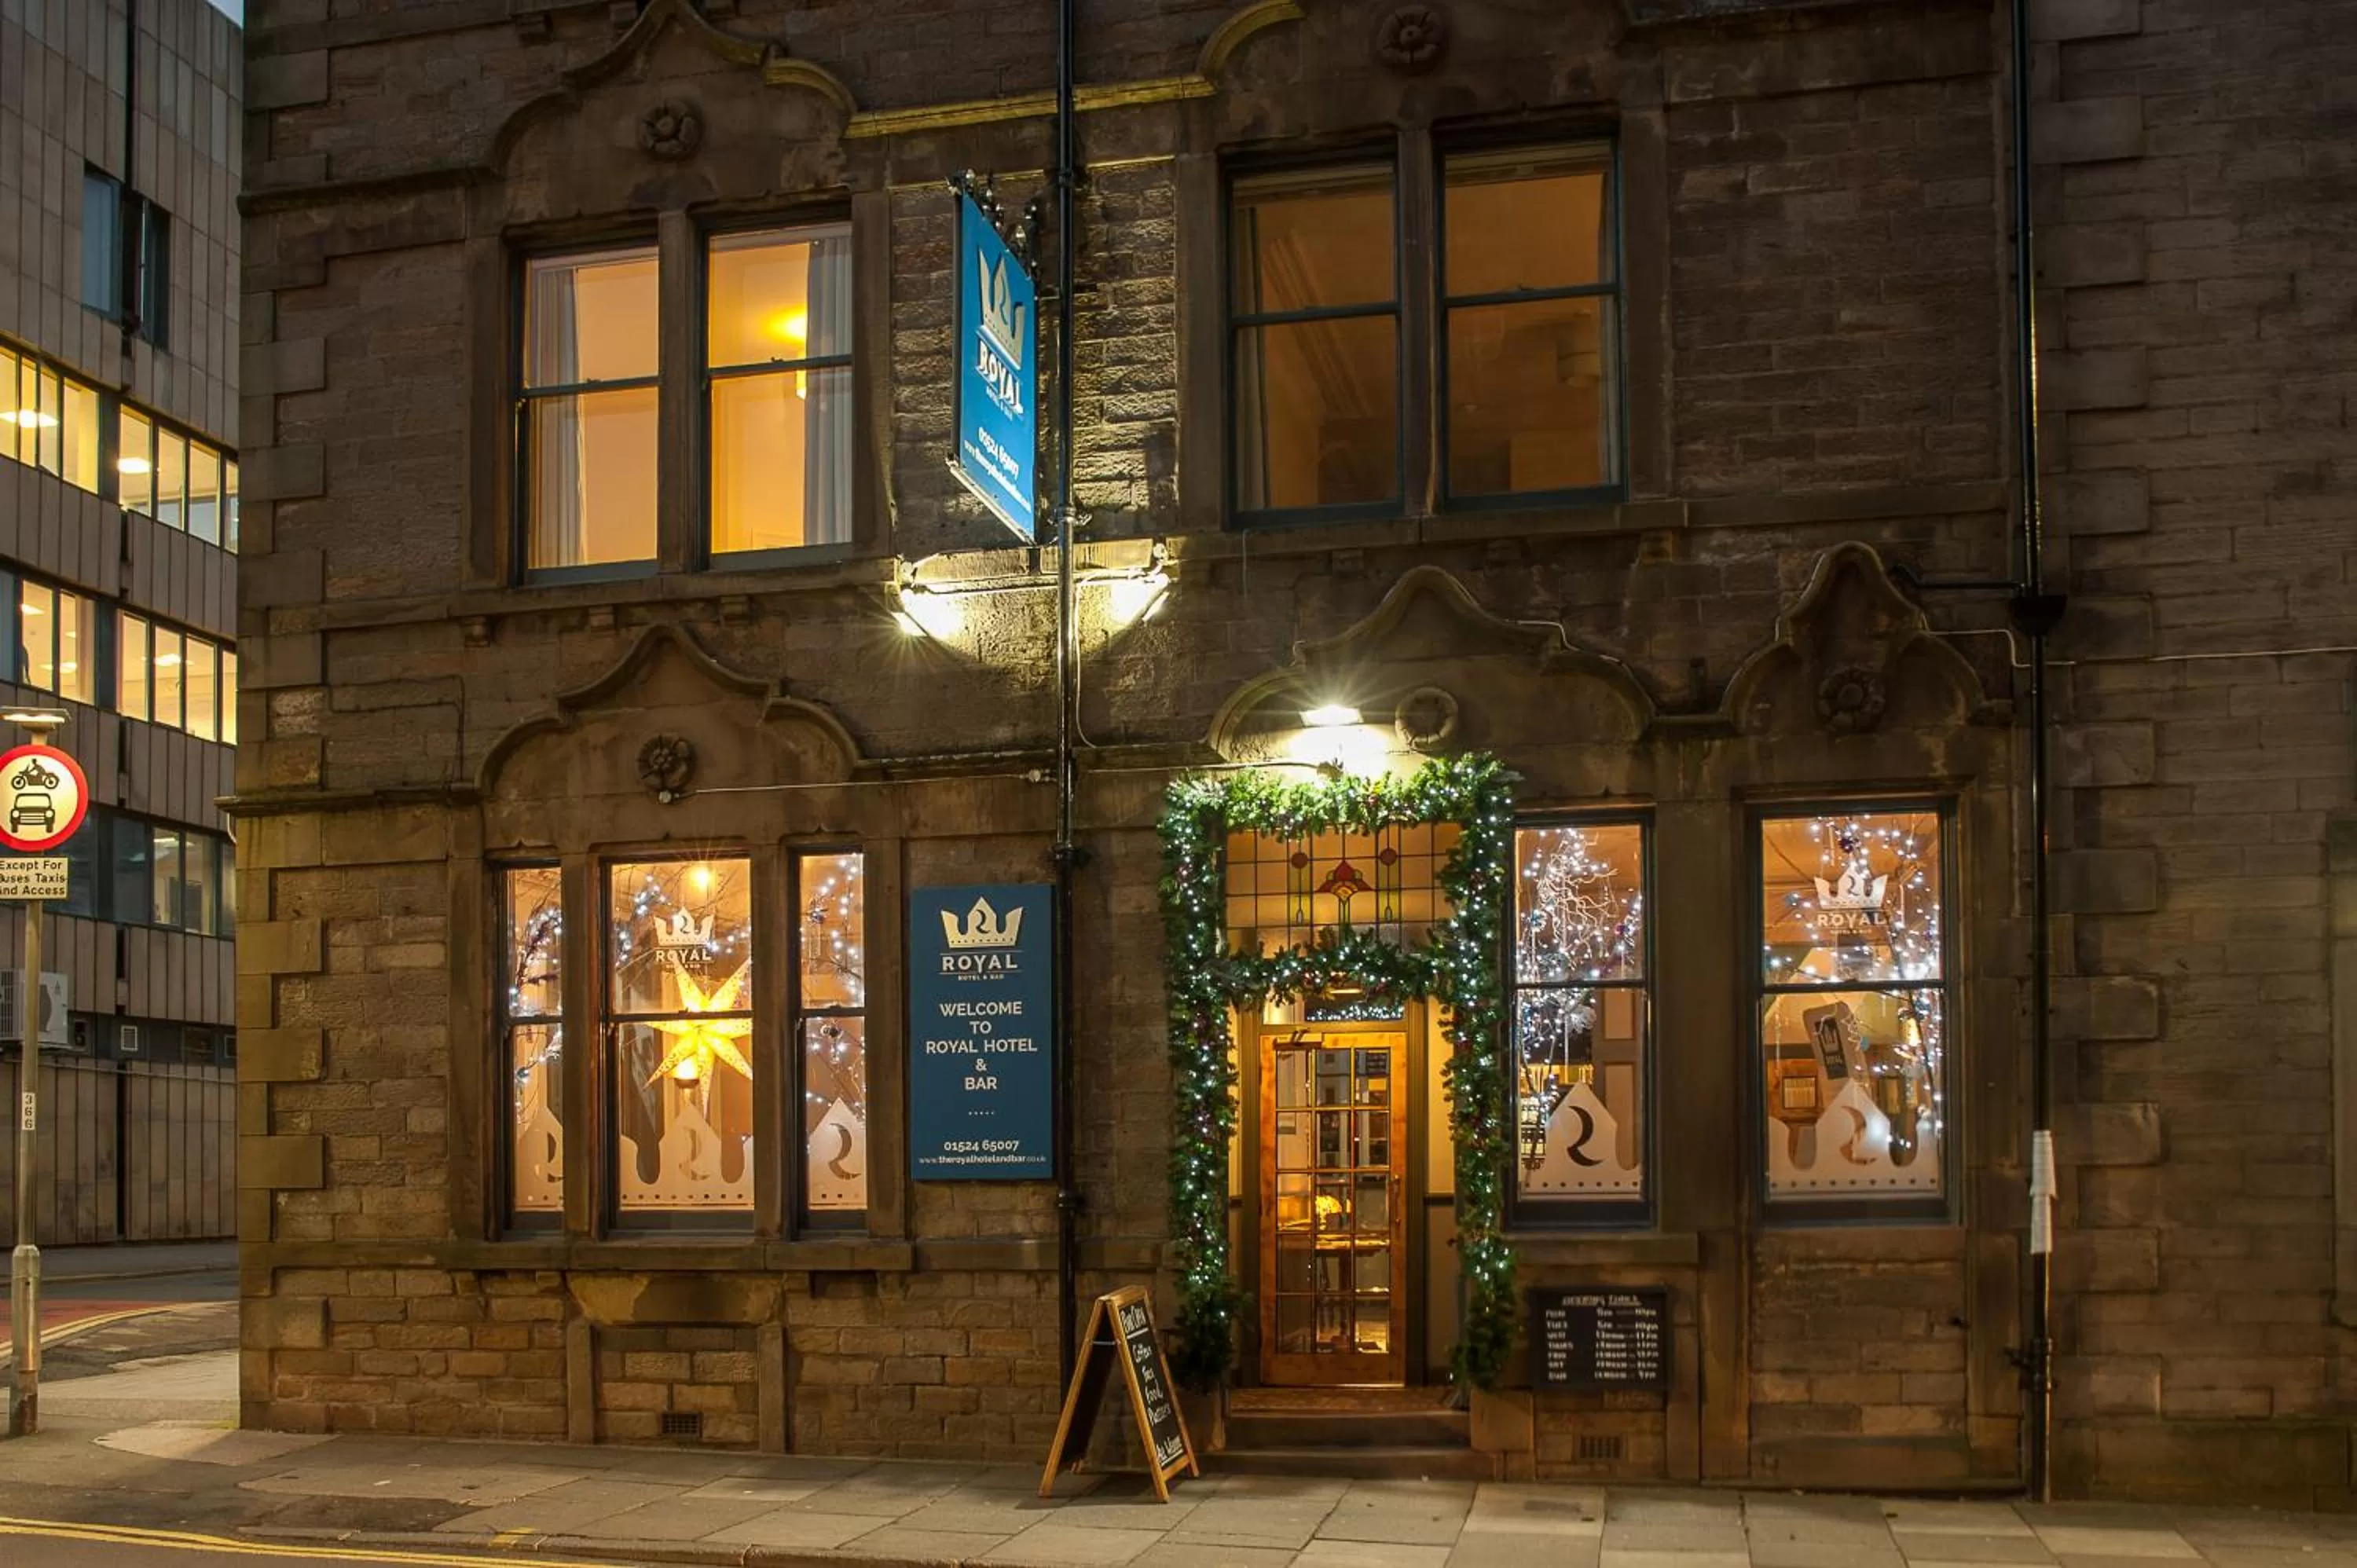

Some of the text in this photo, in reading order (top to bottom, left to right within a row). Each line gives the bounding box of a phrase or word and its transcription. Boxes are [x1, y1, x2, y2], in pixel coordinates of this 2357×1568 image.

[978, 339, 1024, 414] ROYAL
[43, 860, 63, 870] For
[35, 873, 65, 883] Taxis
[22, 885, 65, 895] Access
[1817, 912, 1886, 929] ROYAL
[656, 948, 712, 964] ROYAL
[942, 954, 1018, 973] ROYAL
[940, 1001, 1022, 1017] WELCOME
[970, 1020, 992, 1034] TO
[926, 1038, 1038, 1053] ROYAL HOTEL
[975, 1058, 987, 1072] &
[965, 1076, 997, 1090] BAR
[944, 1139, 1019, 1152] 01524 65007
